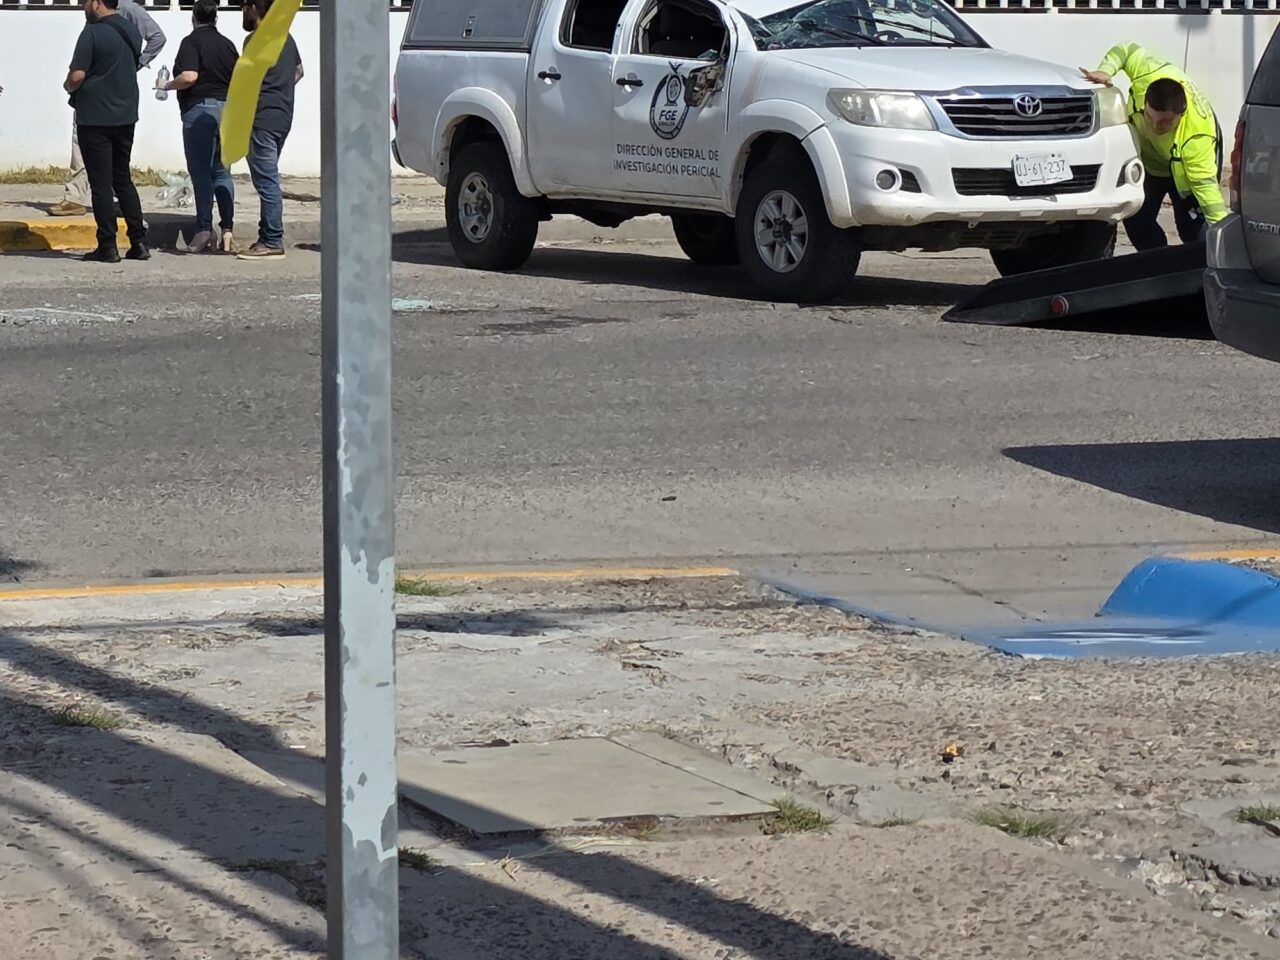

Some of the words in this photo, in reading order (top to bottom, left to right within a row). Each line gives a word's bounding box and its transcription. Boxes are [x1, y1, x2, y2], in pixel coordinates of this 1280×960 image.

[659, 110, 678, 121] FGE
[616, 143, 663, 157] DIRECCIÓN
[665, 147, 706, 160] GENERAL
[708, 150, 720, 161] DE
[613, 159, 679, 175] INVESTIGACIÓN
[680, 165, 721, 178] PERICIAL
